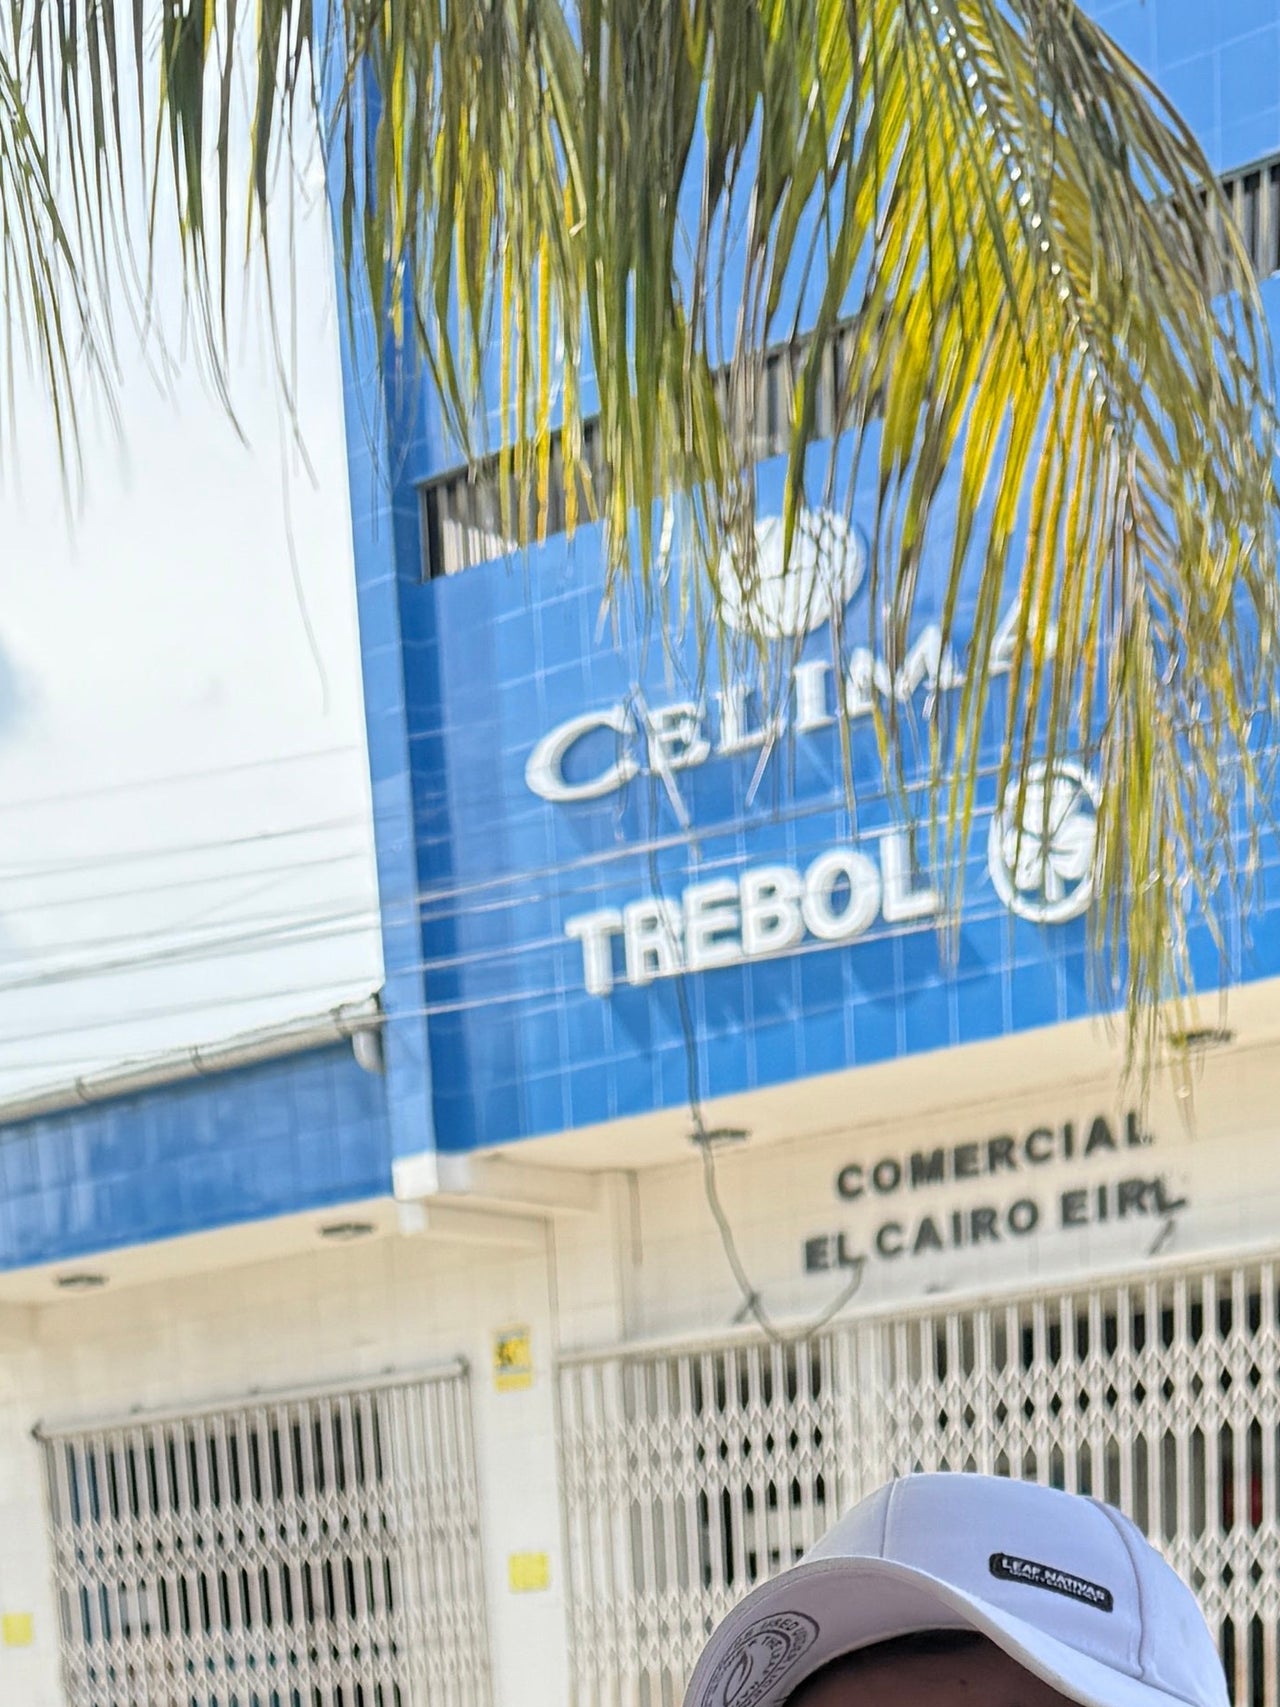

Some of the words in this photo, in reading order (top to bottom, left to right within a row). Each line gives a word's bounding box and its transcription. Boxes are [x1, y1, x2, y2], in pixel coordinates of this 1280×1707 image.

[563, 832, 942, 996] TREBOL
[836, 1111, 1155, 1200] COMERCIAL
[802, 1232, 865, 1274] EL
[874, 1194, 1042, 1260] CAIRO
[1059, 1174, 1189, 1229] EIRL
